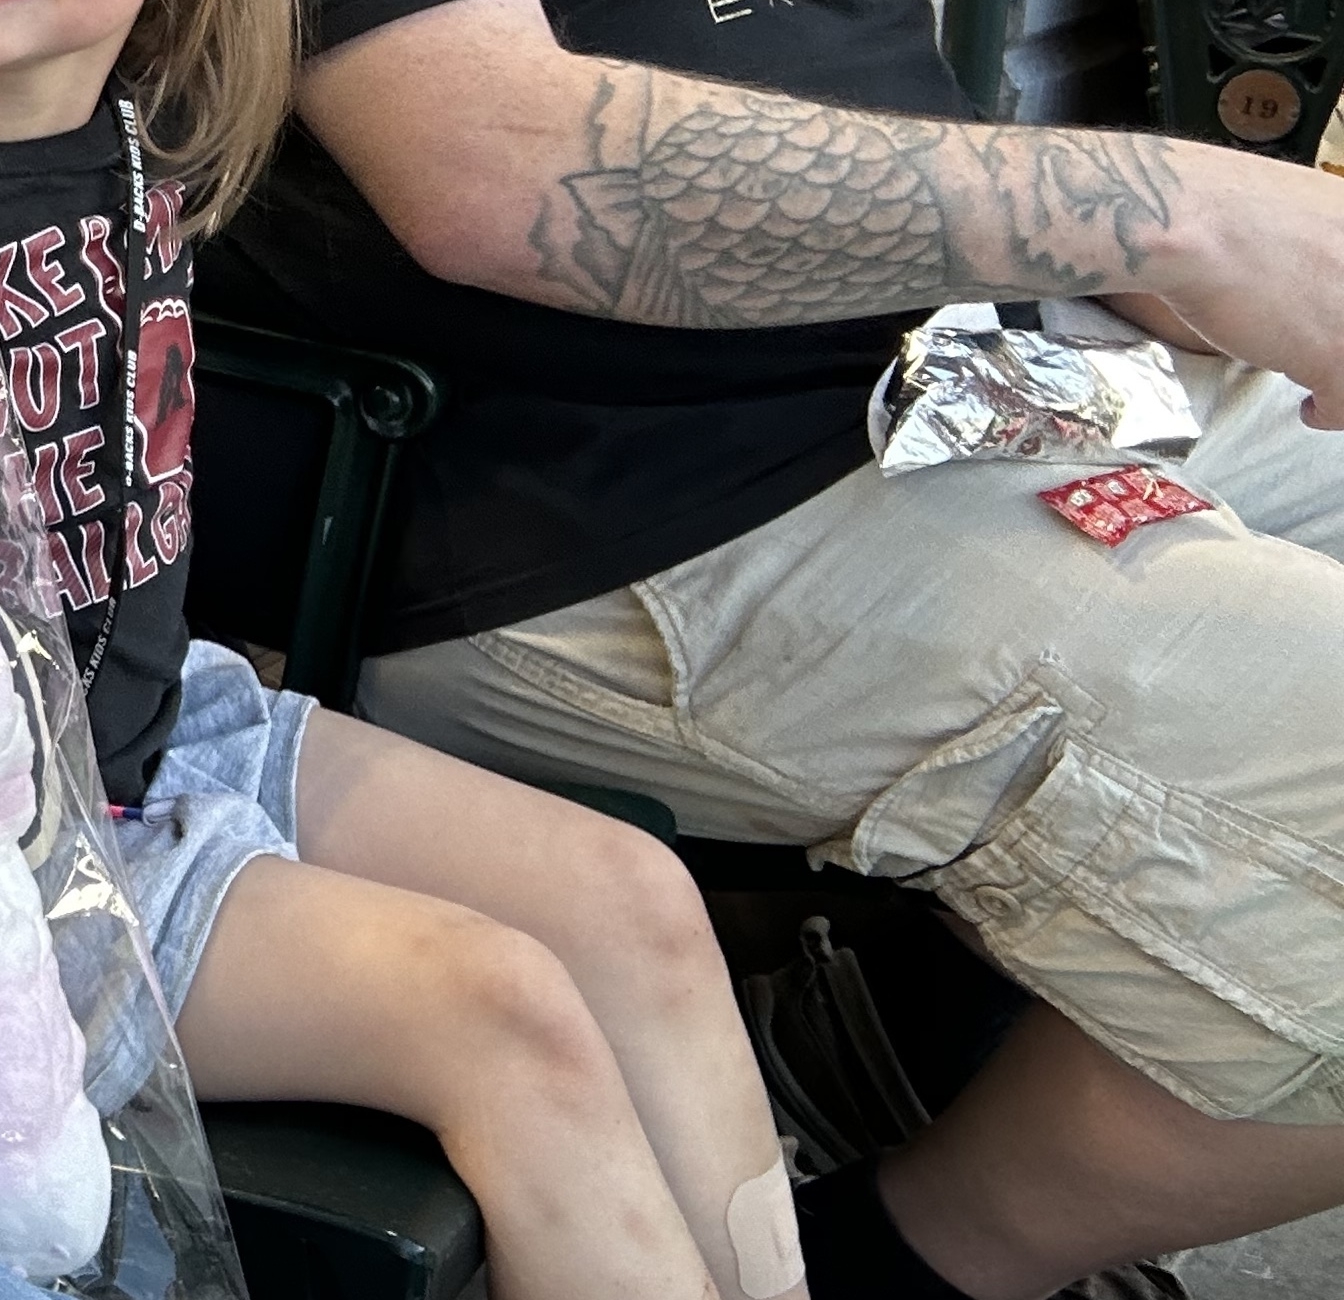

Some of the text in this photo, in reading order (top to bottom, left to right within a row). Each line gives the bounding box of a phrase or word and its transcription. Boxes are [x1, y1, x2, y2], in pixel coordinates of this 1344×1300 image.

[1239, 95, 1280, 120] 19
[118, 99, 147, 233] D-BACKS KIDS CLUB
[124, 349, 138, 487] D-BACKS KIDS CLUB
[88, 633, 108, 670] KIDS
